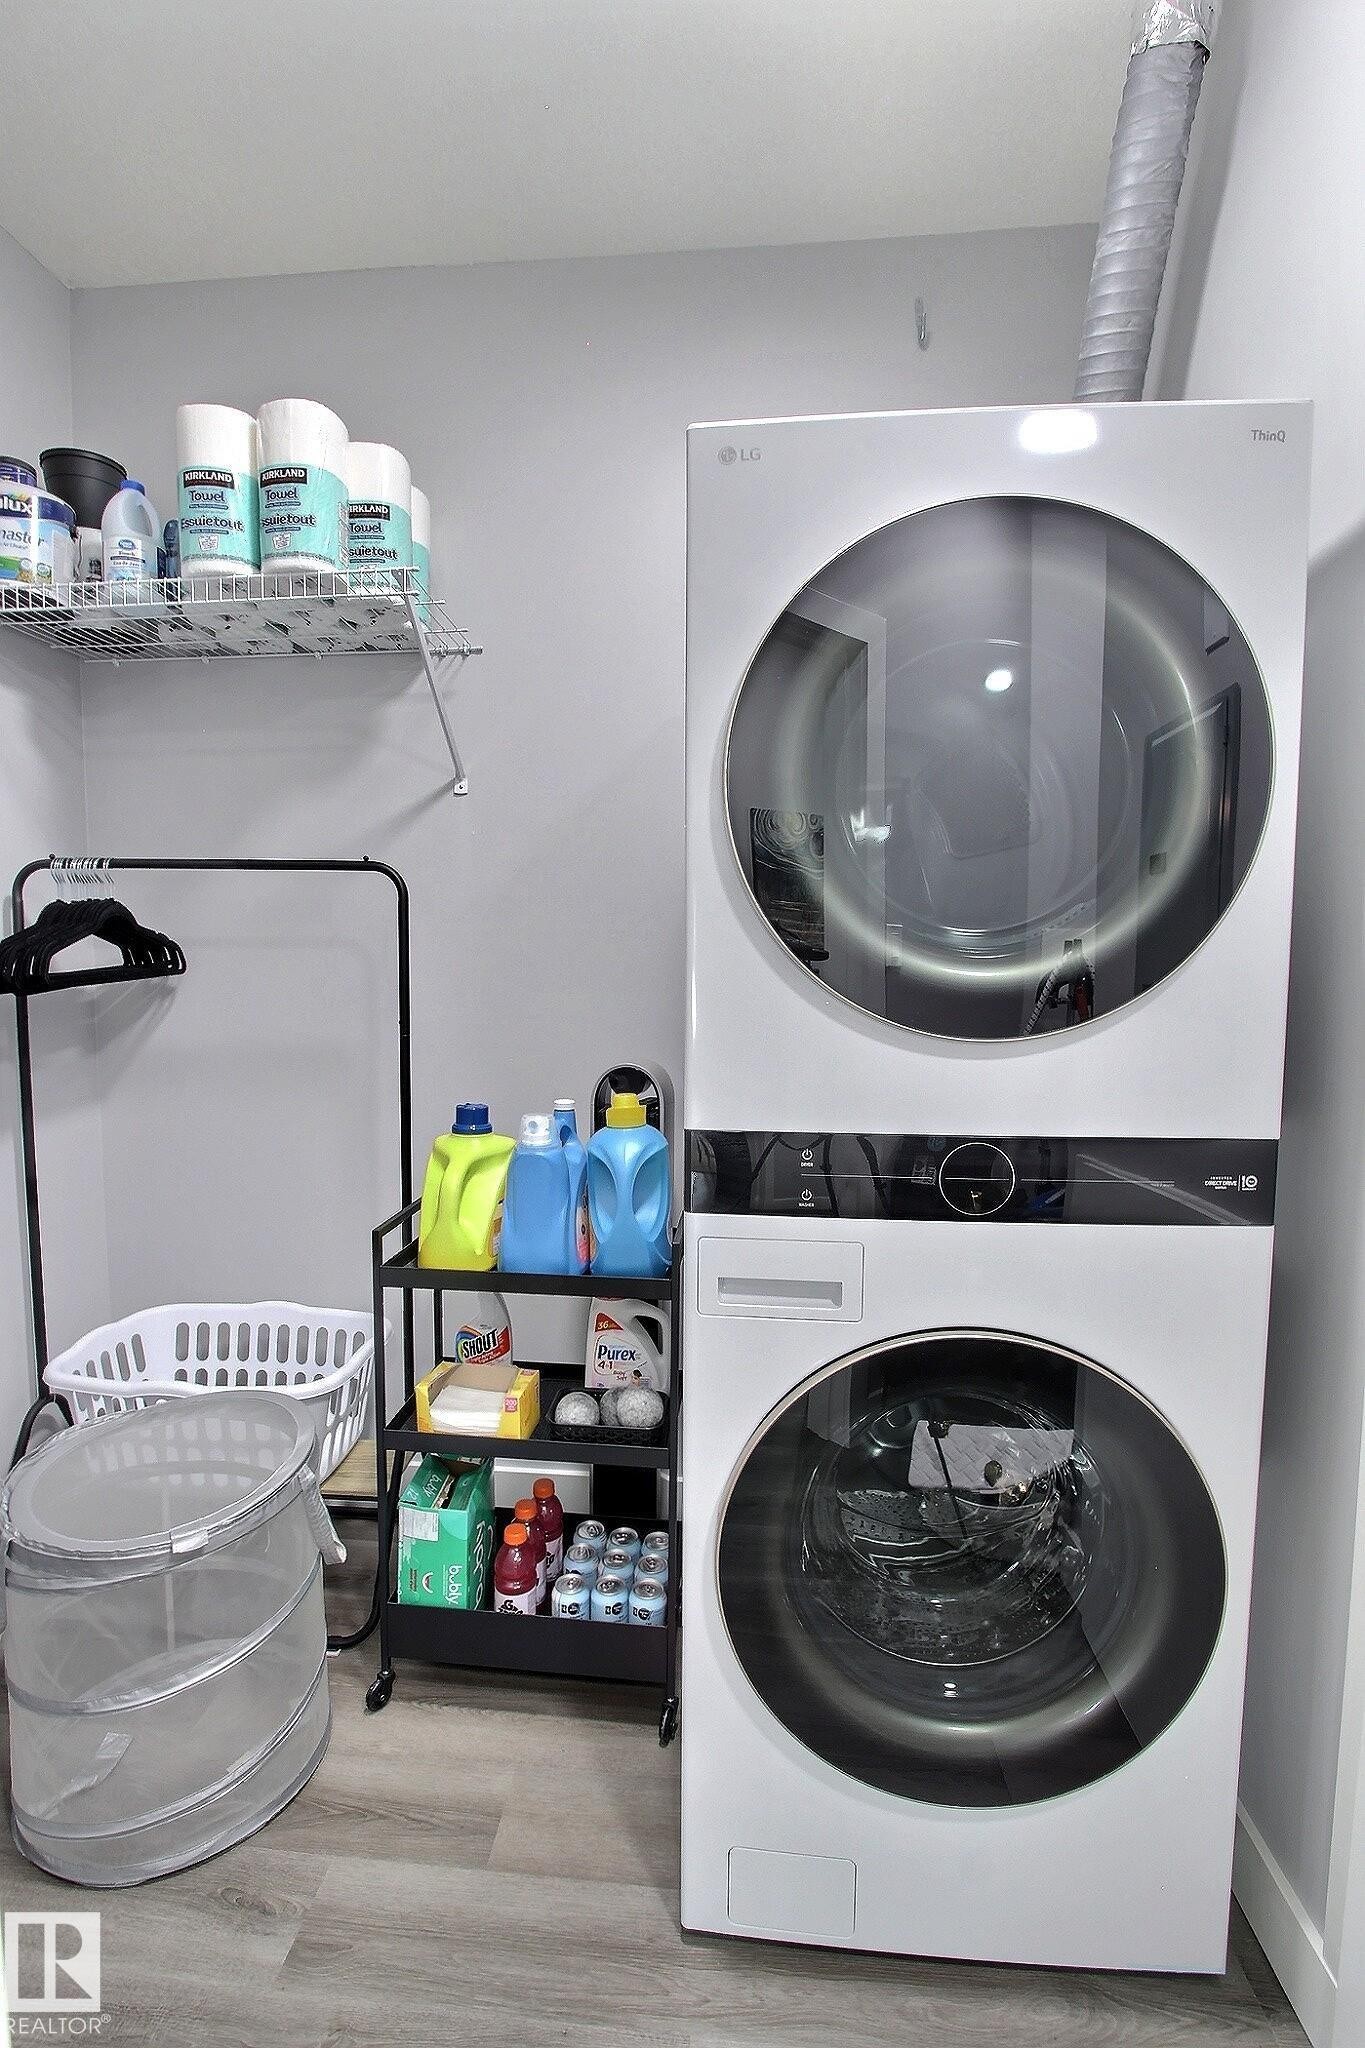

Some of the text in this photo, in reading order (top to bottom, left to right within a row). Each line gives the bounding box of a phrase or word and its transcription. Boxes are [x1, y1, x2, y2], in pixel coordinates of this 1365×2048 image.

[1251, 429, 1286, 443] ThinQ
[741, 447, 761, 461] LG
[184, 471, 233, 483] KIRKLAND
[262, 468, 305, 481] KIRKLAND
[189, 490, 225, 502] Towel
[265, 487, 298, 500] Towel
[349, 504, 389, 514] IRKLAND
[349, 522, 382, 533] Towel
[462, 1328, 498, 1359] SHOUT
[597, 1344, 636, 1361] Purex
